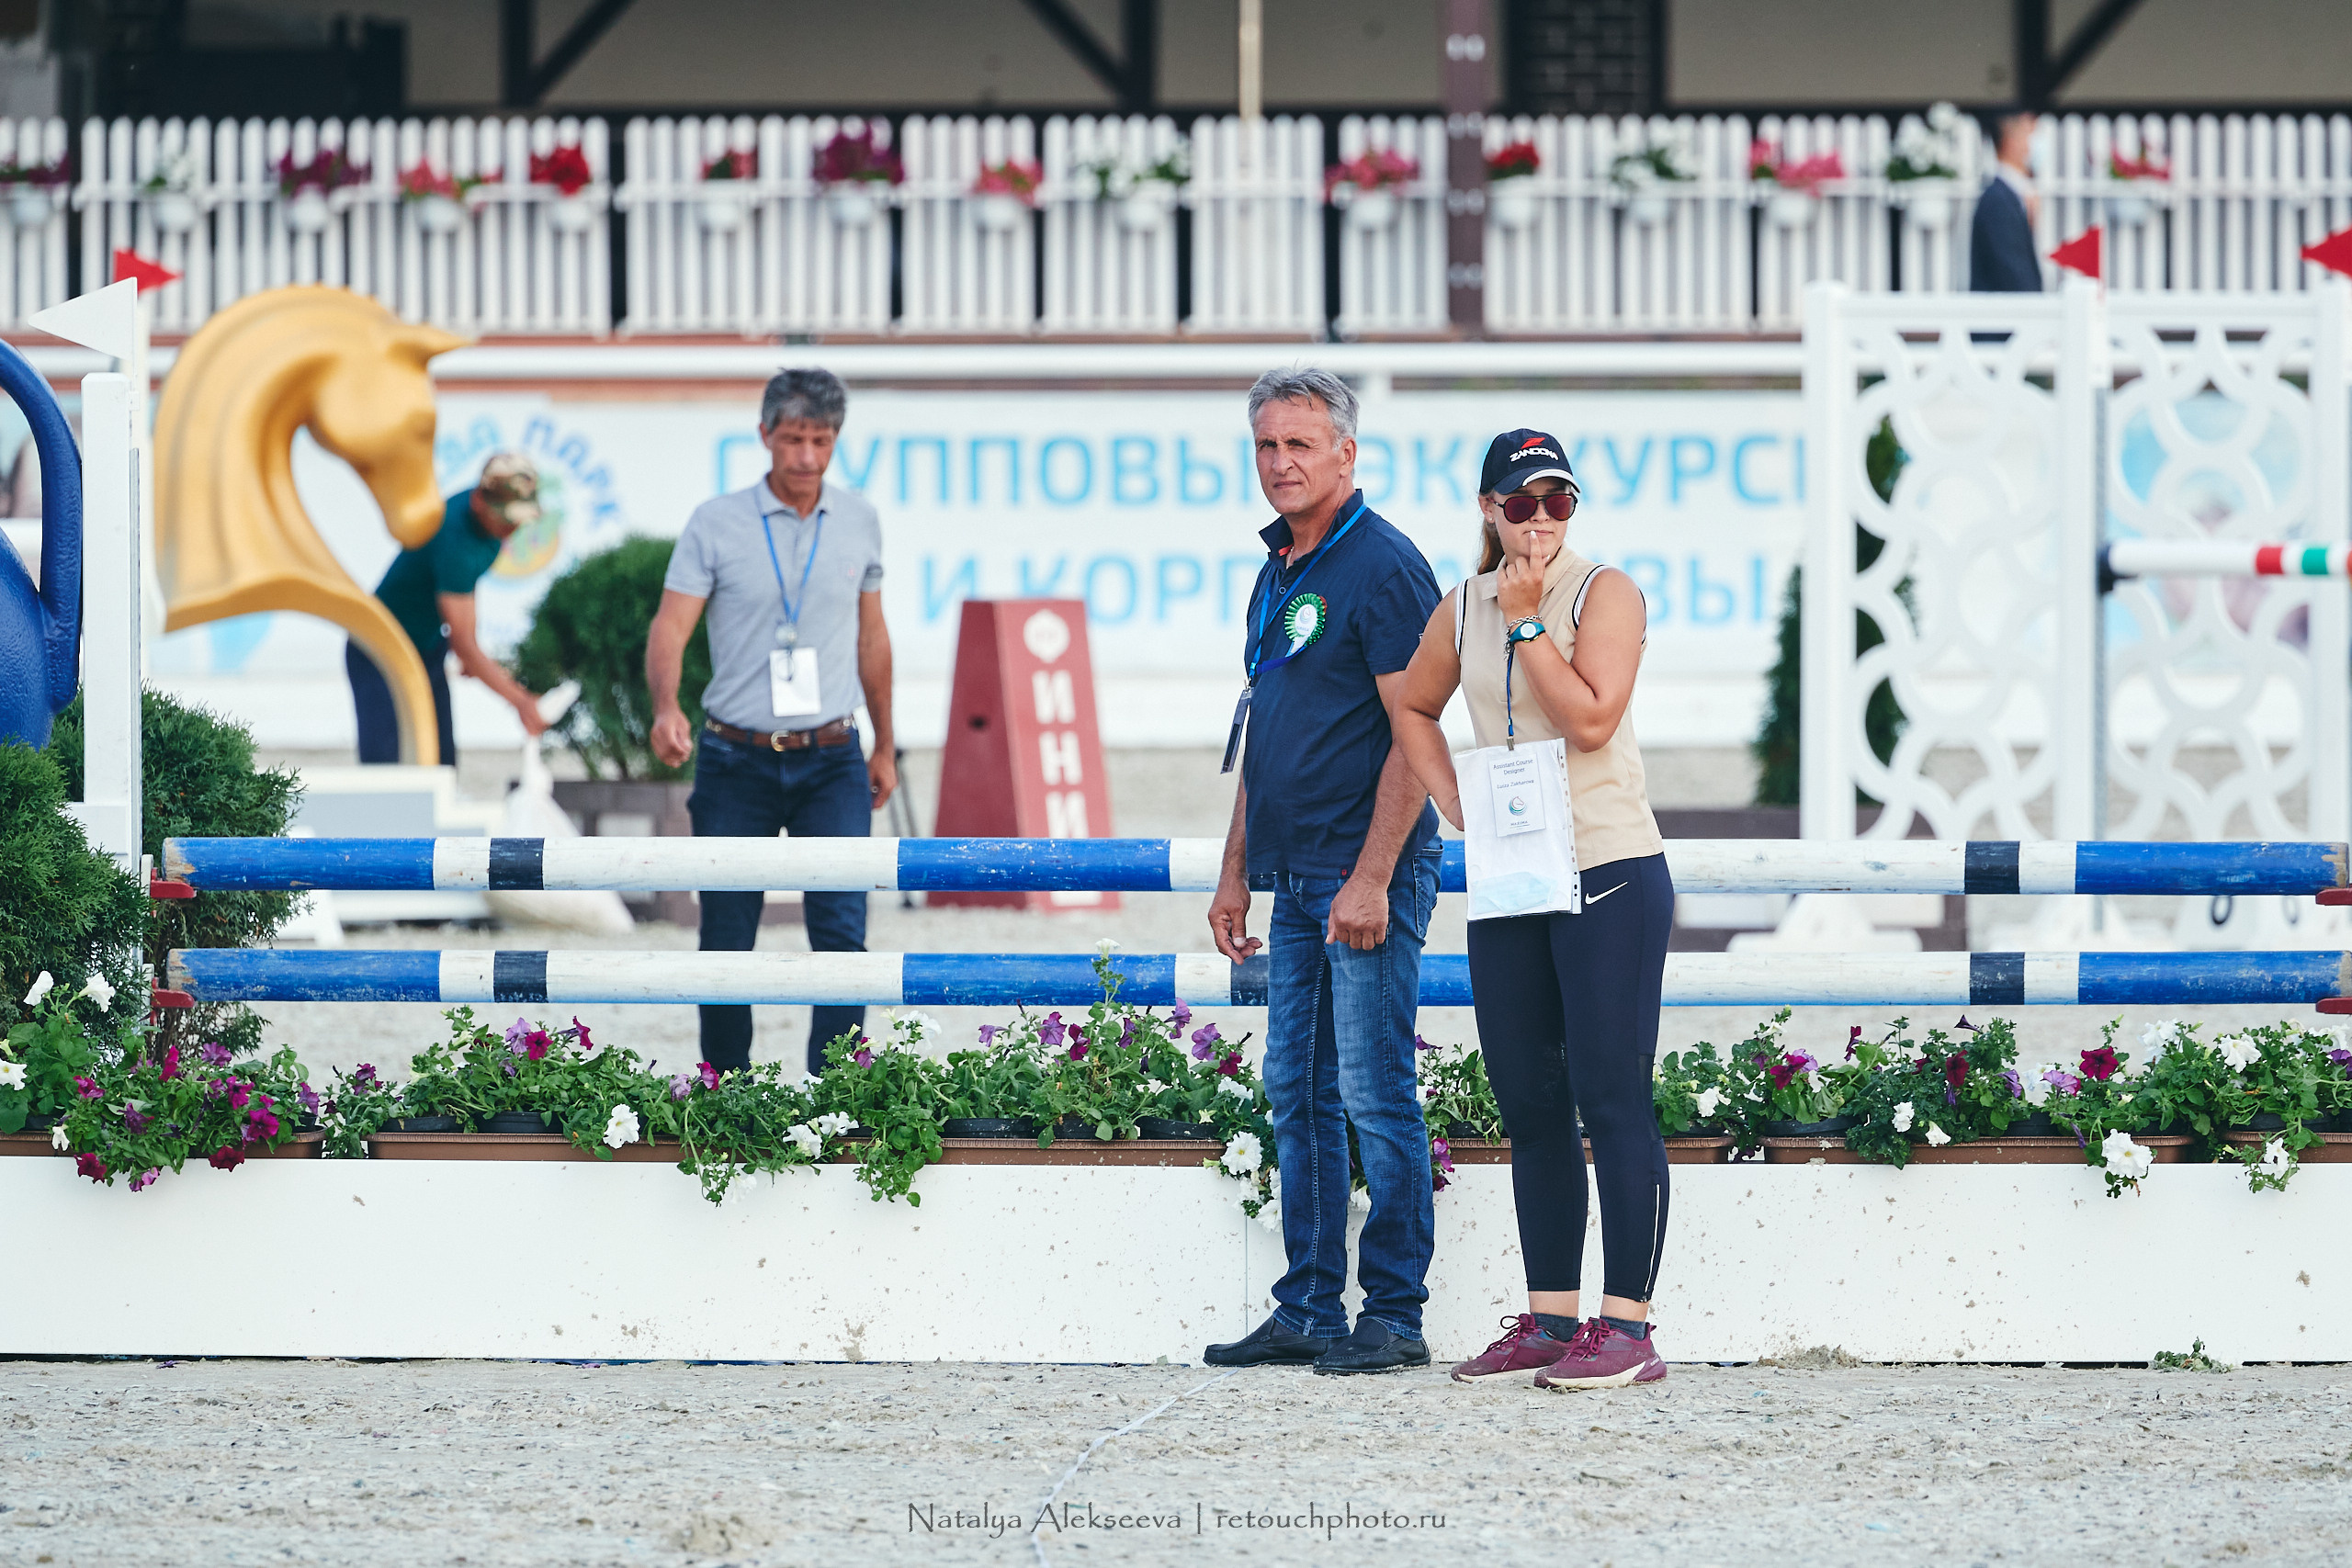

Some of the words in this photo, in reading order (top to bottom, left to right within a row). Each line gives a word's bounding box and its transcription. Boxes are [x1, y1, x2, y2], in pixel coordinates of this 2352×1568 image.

[718, 435, 1253, 505] ГУППОВЫ
[1510, 447, 1558, 462] ZANDONA
[922, 554, 977, 621] И
[1023, 609, 1102, 906] ФИНИ
[1493, 761, 1515, 770] Assistant
